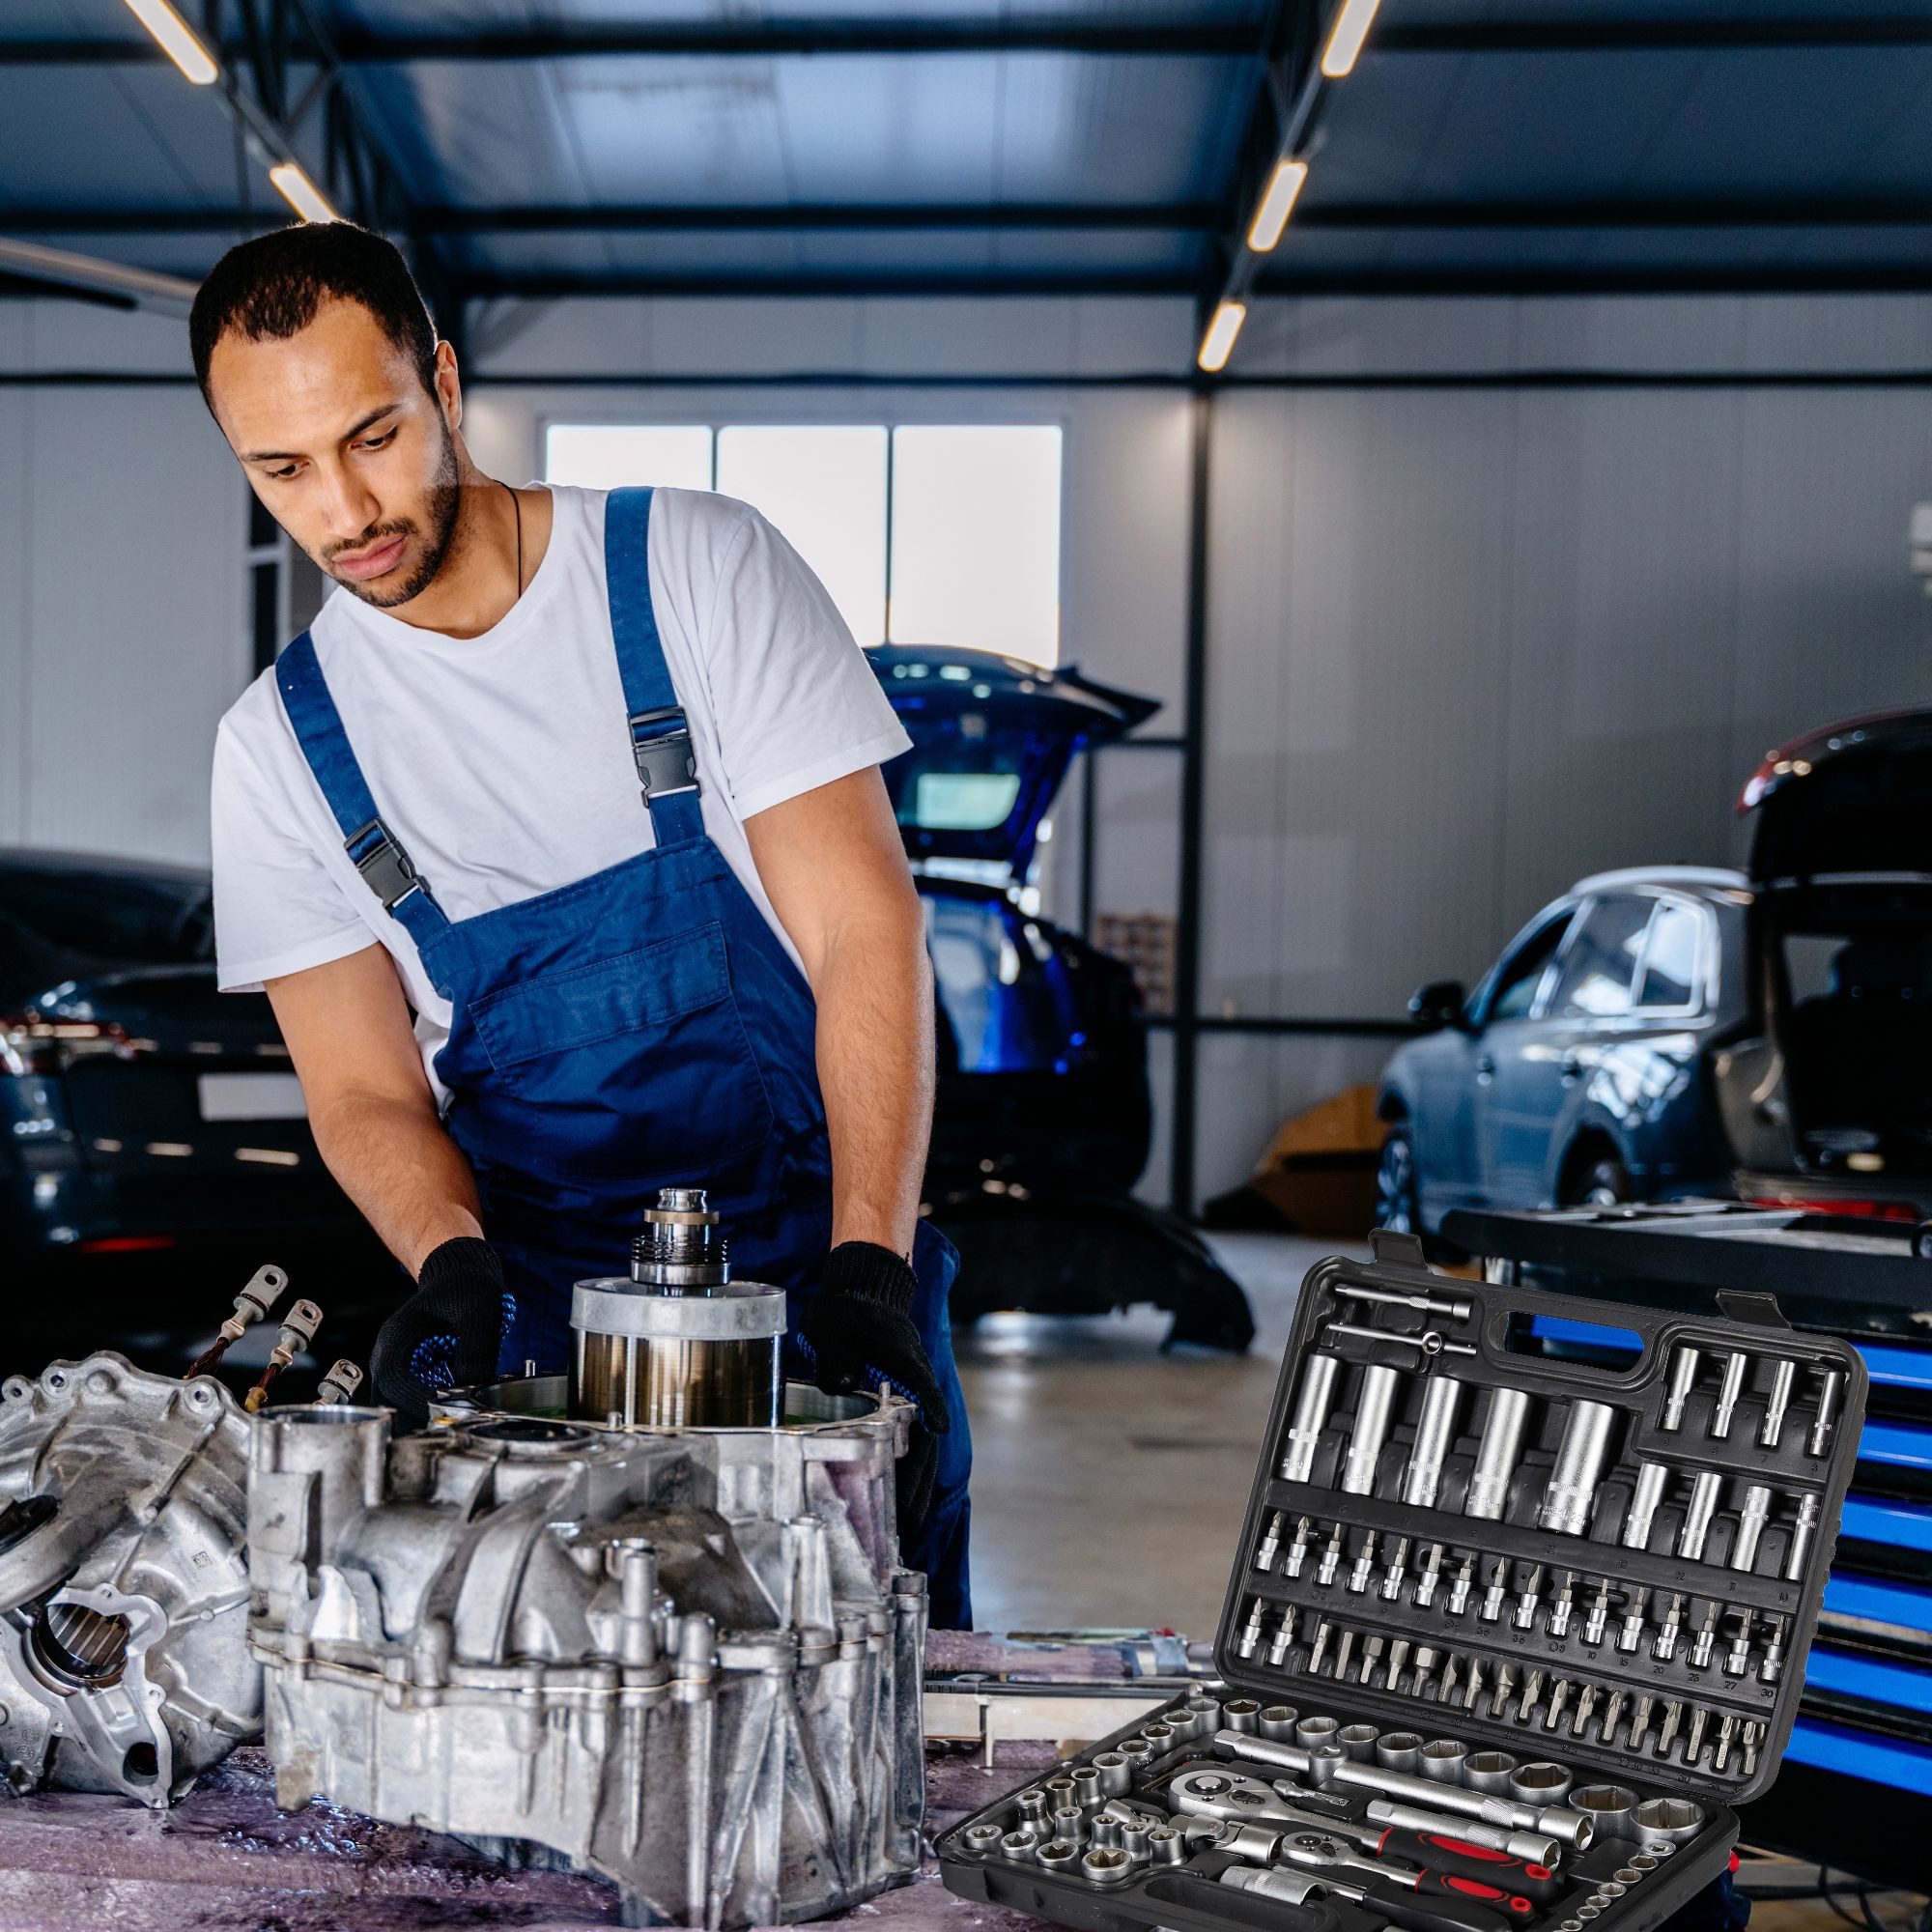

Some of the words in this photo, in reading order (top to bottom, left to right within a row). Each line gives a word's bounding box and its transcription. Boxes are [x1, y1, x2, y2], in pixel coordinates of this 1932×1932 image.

[1587, 1650, 1597, 1661] 10
[1619, 1657, 1630, 1667] 15
[1652, 1664, 1665, 1675] 20
[1688, 1672, 1700, 1683] 25
[1722, 1680, 1738, 1690] 27
[1760, 1688, 1775, 1699] 30
